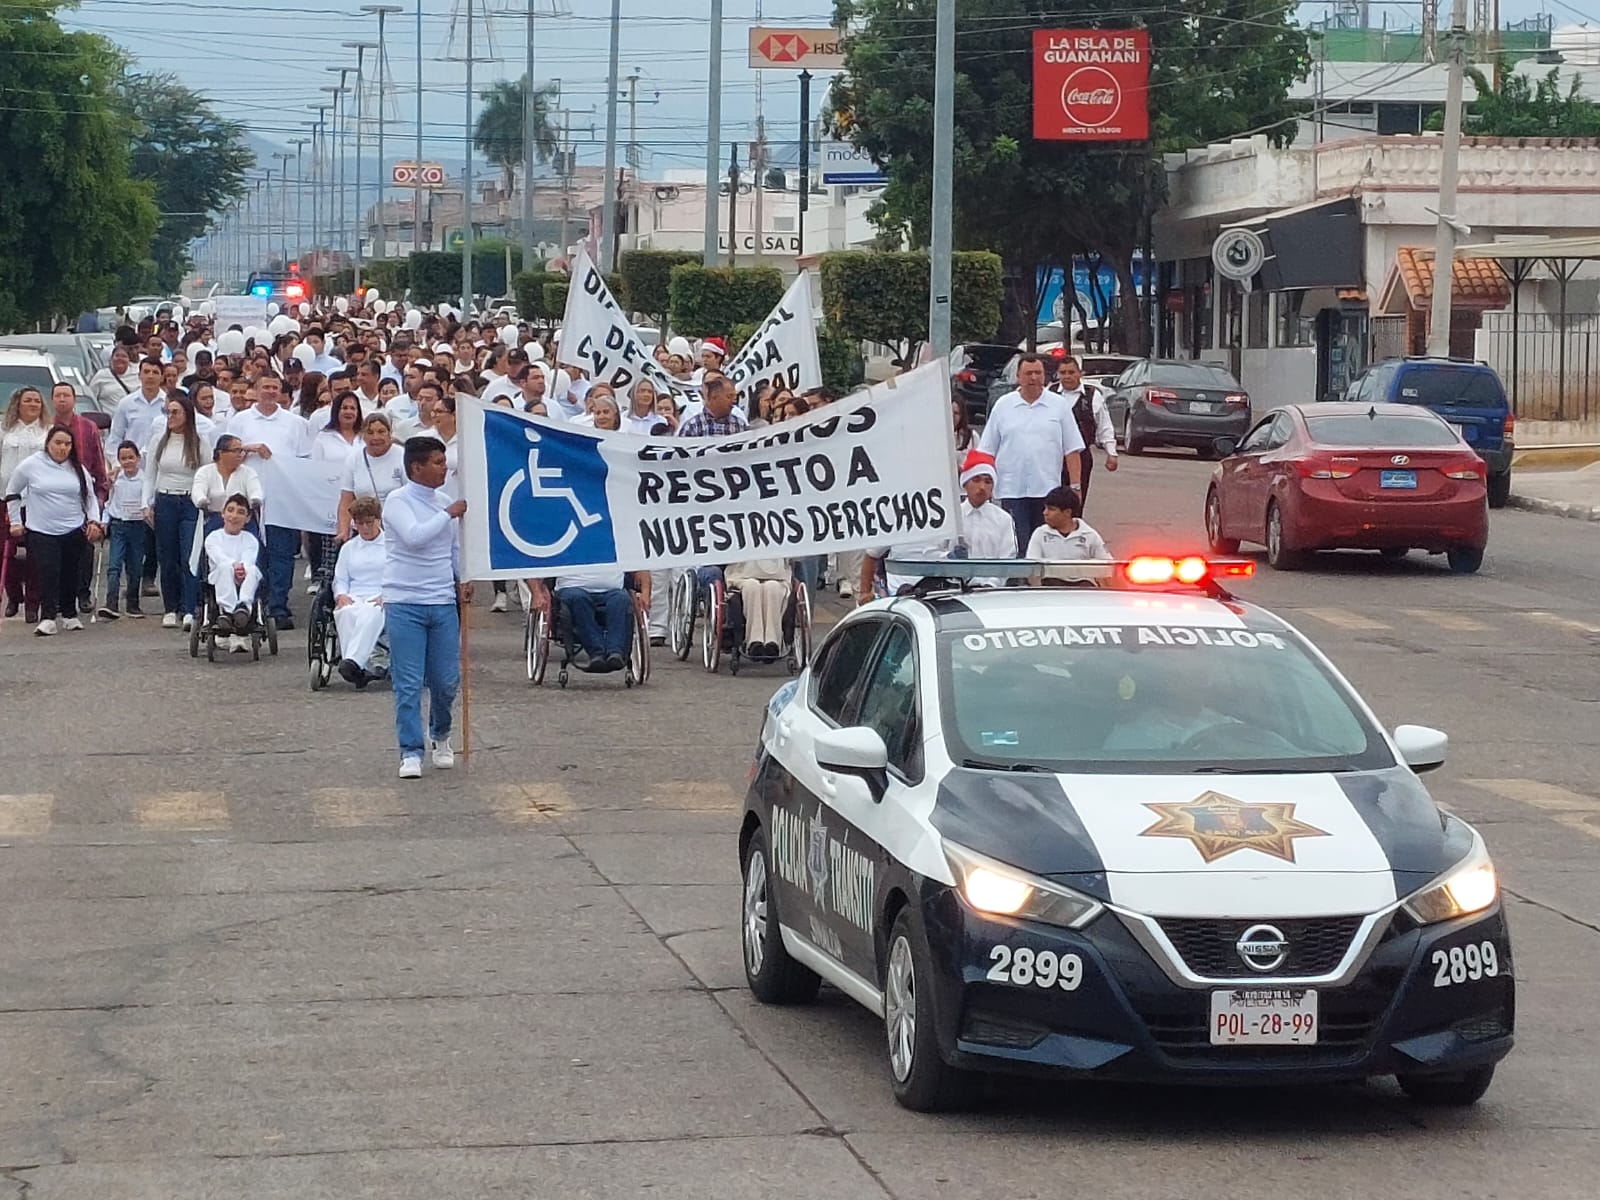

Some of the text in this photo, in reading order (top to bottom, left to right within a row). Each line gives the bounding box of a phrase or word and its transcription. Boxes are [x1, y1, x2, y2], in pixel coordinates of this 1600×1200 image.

[1044, 51, 1140, 63] GUANAHANI
[1050, 38, 1134, 49] LA ISLA DE
[719, 237, 737, 249] L
[744, 236, 785, 250] CSA
[637, 445, 879, 505] RESPETO A
[638, 487, 946, 559] NUESTROS DERECHOS
[986, 944, 1083, 991] 2899
[1432, 941, 1498, 987] 2899
[1217, 1013, 1313, 1036] POL-28-99
